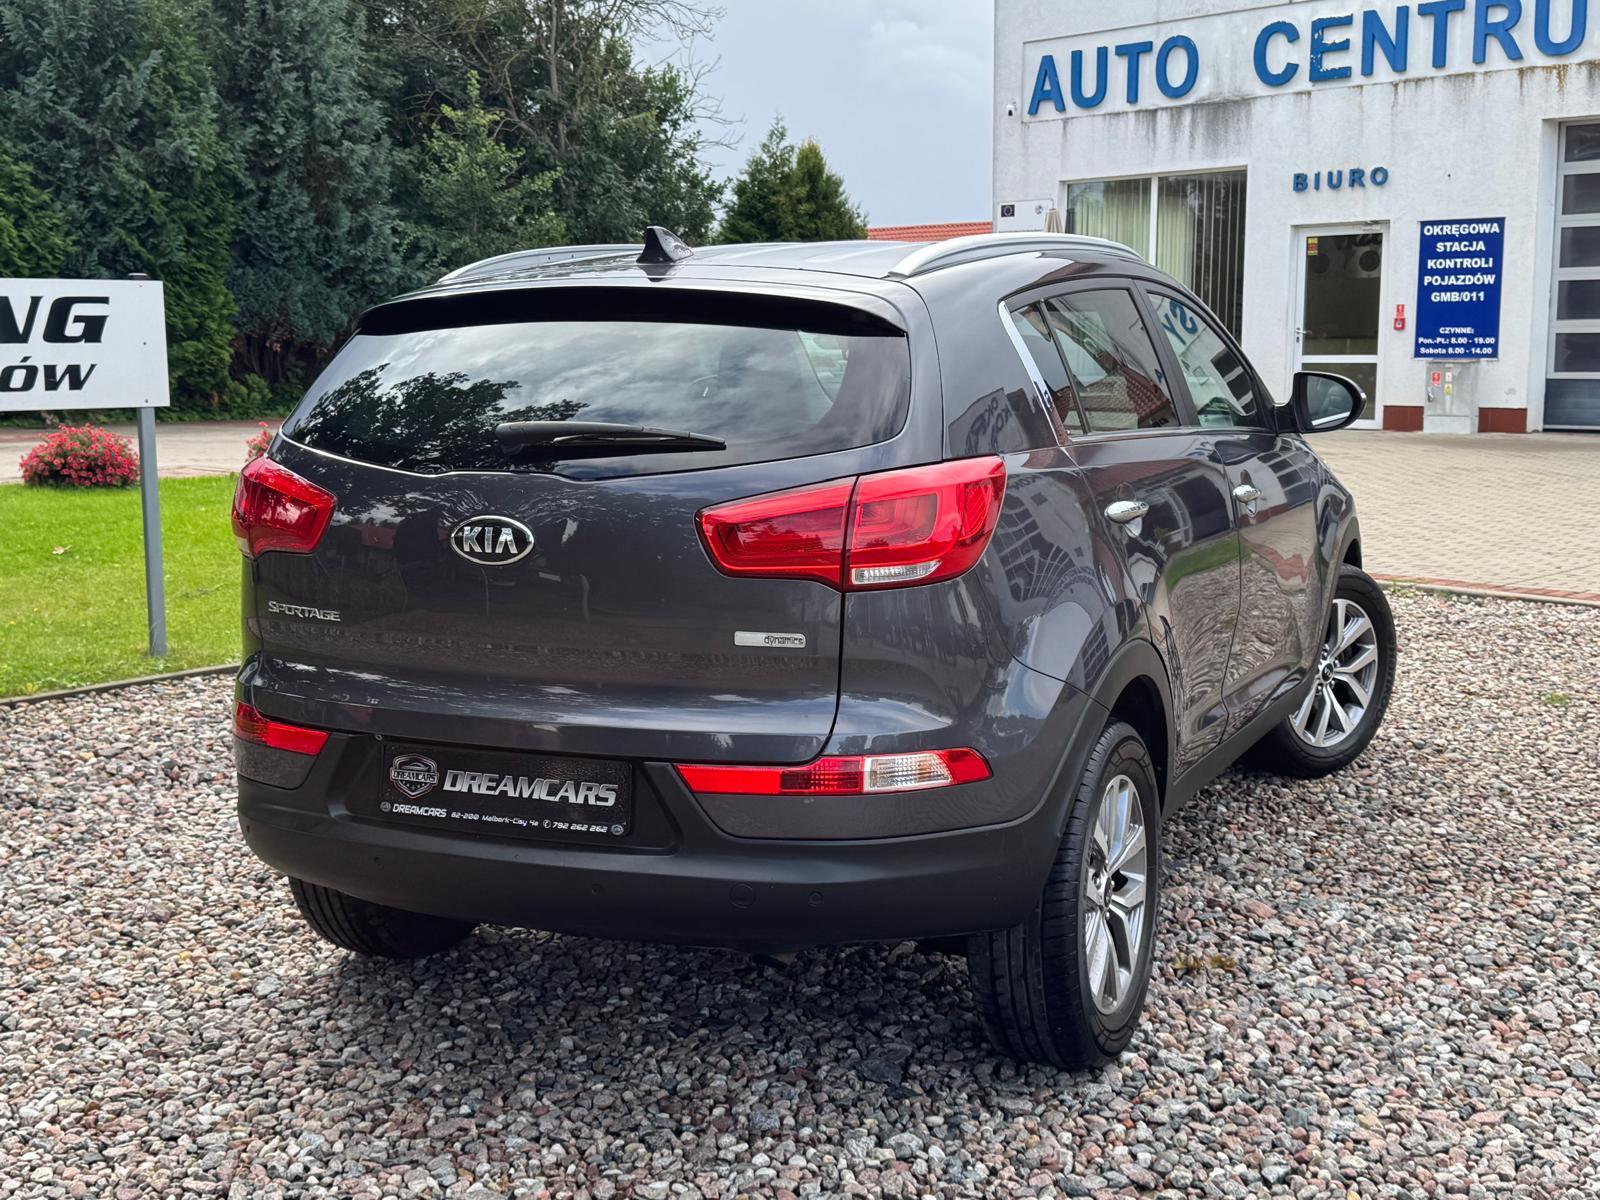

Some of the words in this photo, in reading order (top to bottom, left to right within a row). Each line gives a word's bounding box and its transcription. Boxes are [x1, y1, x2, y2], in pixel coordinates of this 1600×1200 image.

[1028, 35, 1200, 116] AUTO
[1252, 0, 1589, 87] CENTRU
[1293, 166, 1389, 193] BIURO
[1423, 222, 1500, 238] OKRĘGOWA
[1435, 241, 1486, 253] STACJA
[1427, 257, 1494, 270] KONTROLI
[1423, 272, 1496, 287] POJAZDÓW
[1430, 291, 1485, 303] GMB/011
[1439, 326, 1475, 335] CZYNNE:
[1450, 337, 1468, 345] 8.00
[1474, 337, 1496, 345] 19.00
[1419, 347, 1447, 355] Sobota
[1447, 347, 1465, 355] 8.00
[1471, 347, 1493, 355] 14.00
[462, 526, 519, 554] KIA
[267, 600, 342, 622] SPORTAGE
[763, 635, 804, 646] dynamics
[442, 769, 619, 807] DREAMCARS
[392, 803, 448, 818] DREAMCARS
[552, 820, 570, 830] 792
[570, 823, 589, 832] 262
[589, 824, 609, 833] 262
